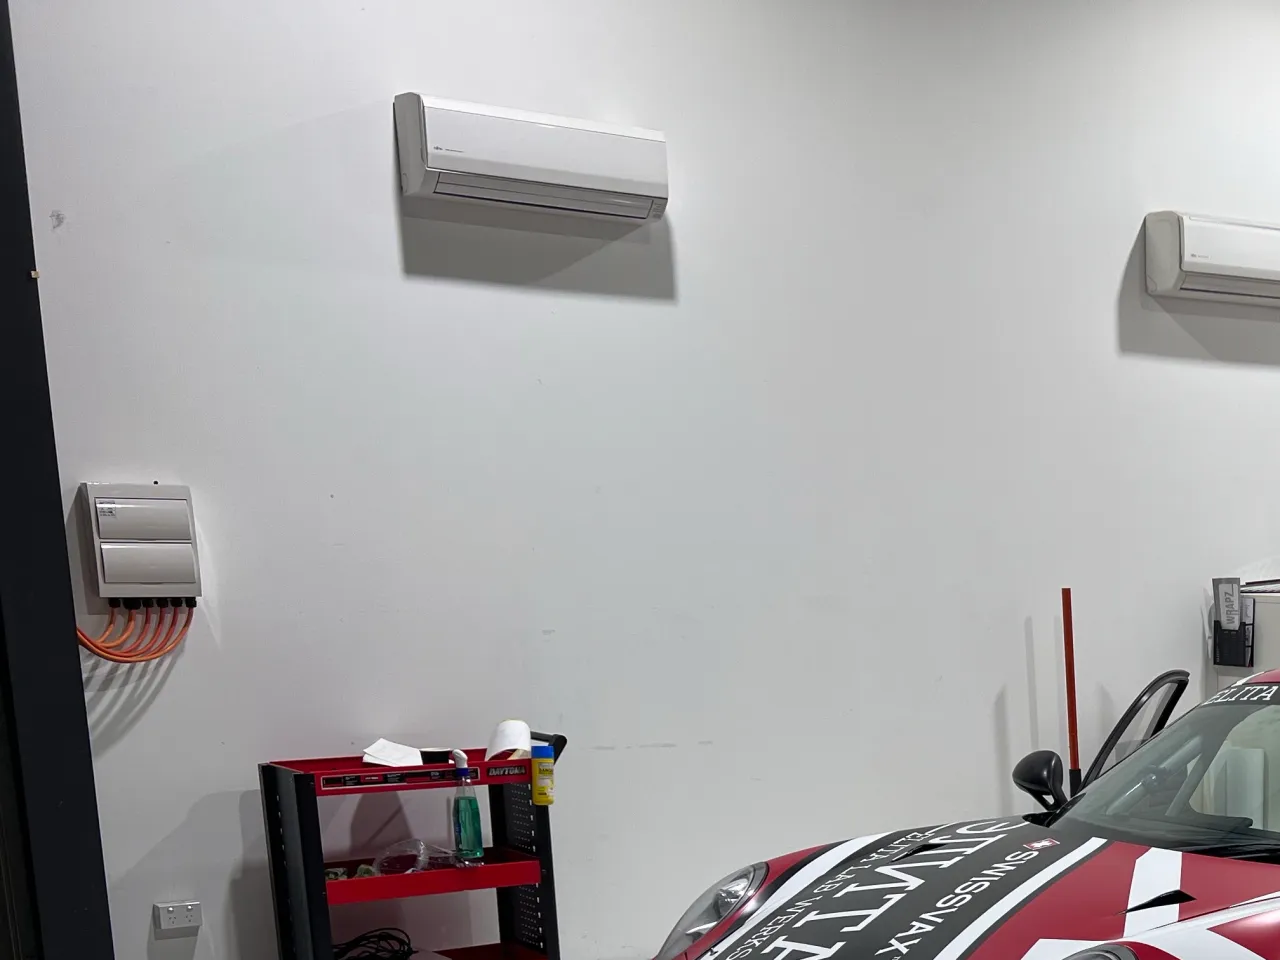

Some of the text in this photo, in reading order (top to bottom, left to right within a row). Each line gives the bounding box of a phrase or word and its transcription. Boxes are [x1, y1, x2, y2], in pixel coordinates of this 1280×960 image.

[1206, 686, 1278, 705] ELITA
[488, 766, 526, 776] DAYTONA
[726, 831, 935, 960] ELITA LAB WERKS
